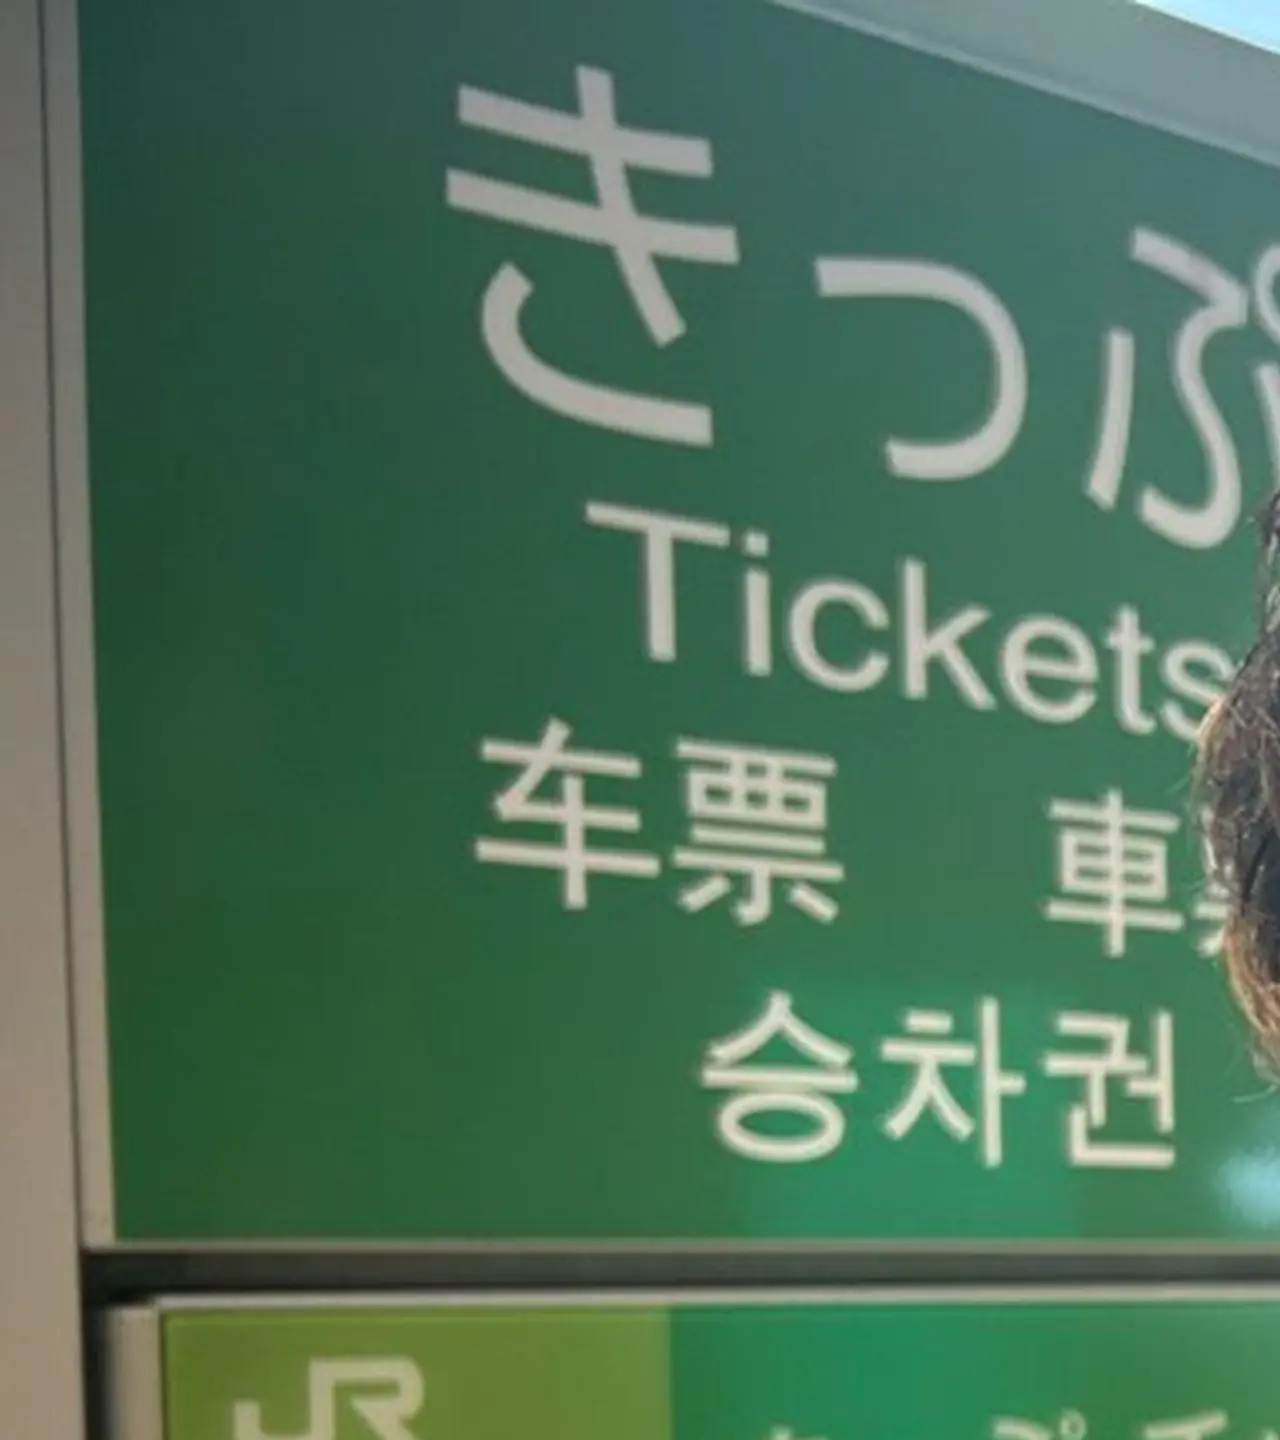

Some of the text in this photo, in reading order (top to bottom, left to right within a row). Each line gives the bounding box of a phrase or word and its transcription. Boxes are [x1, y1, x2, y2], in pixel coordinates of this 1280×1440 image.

[584, 500, 1240, 745] Tickets
[474, 717, 1240, 958] 车票 車
[700, 990, 1177, 1170] 승차권
